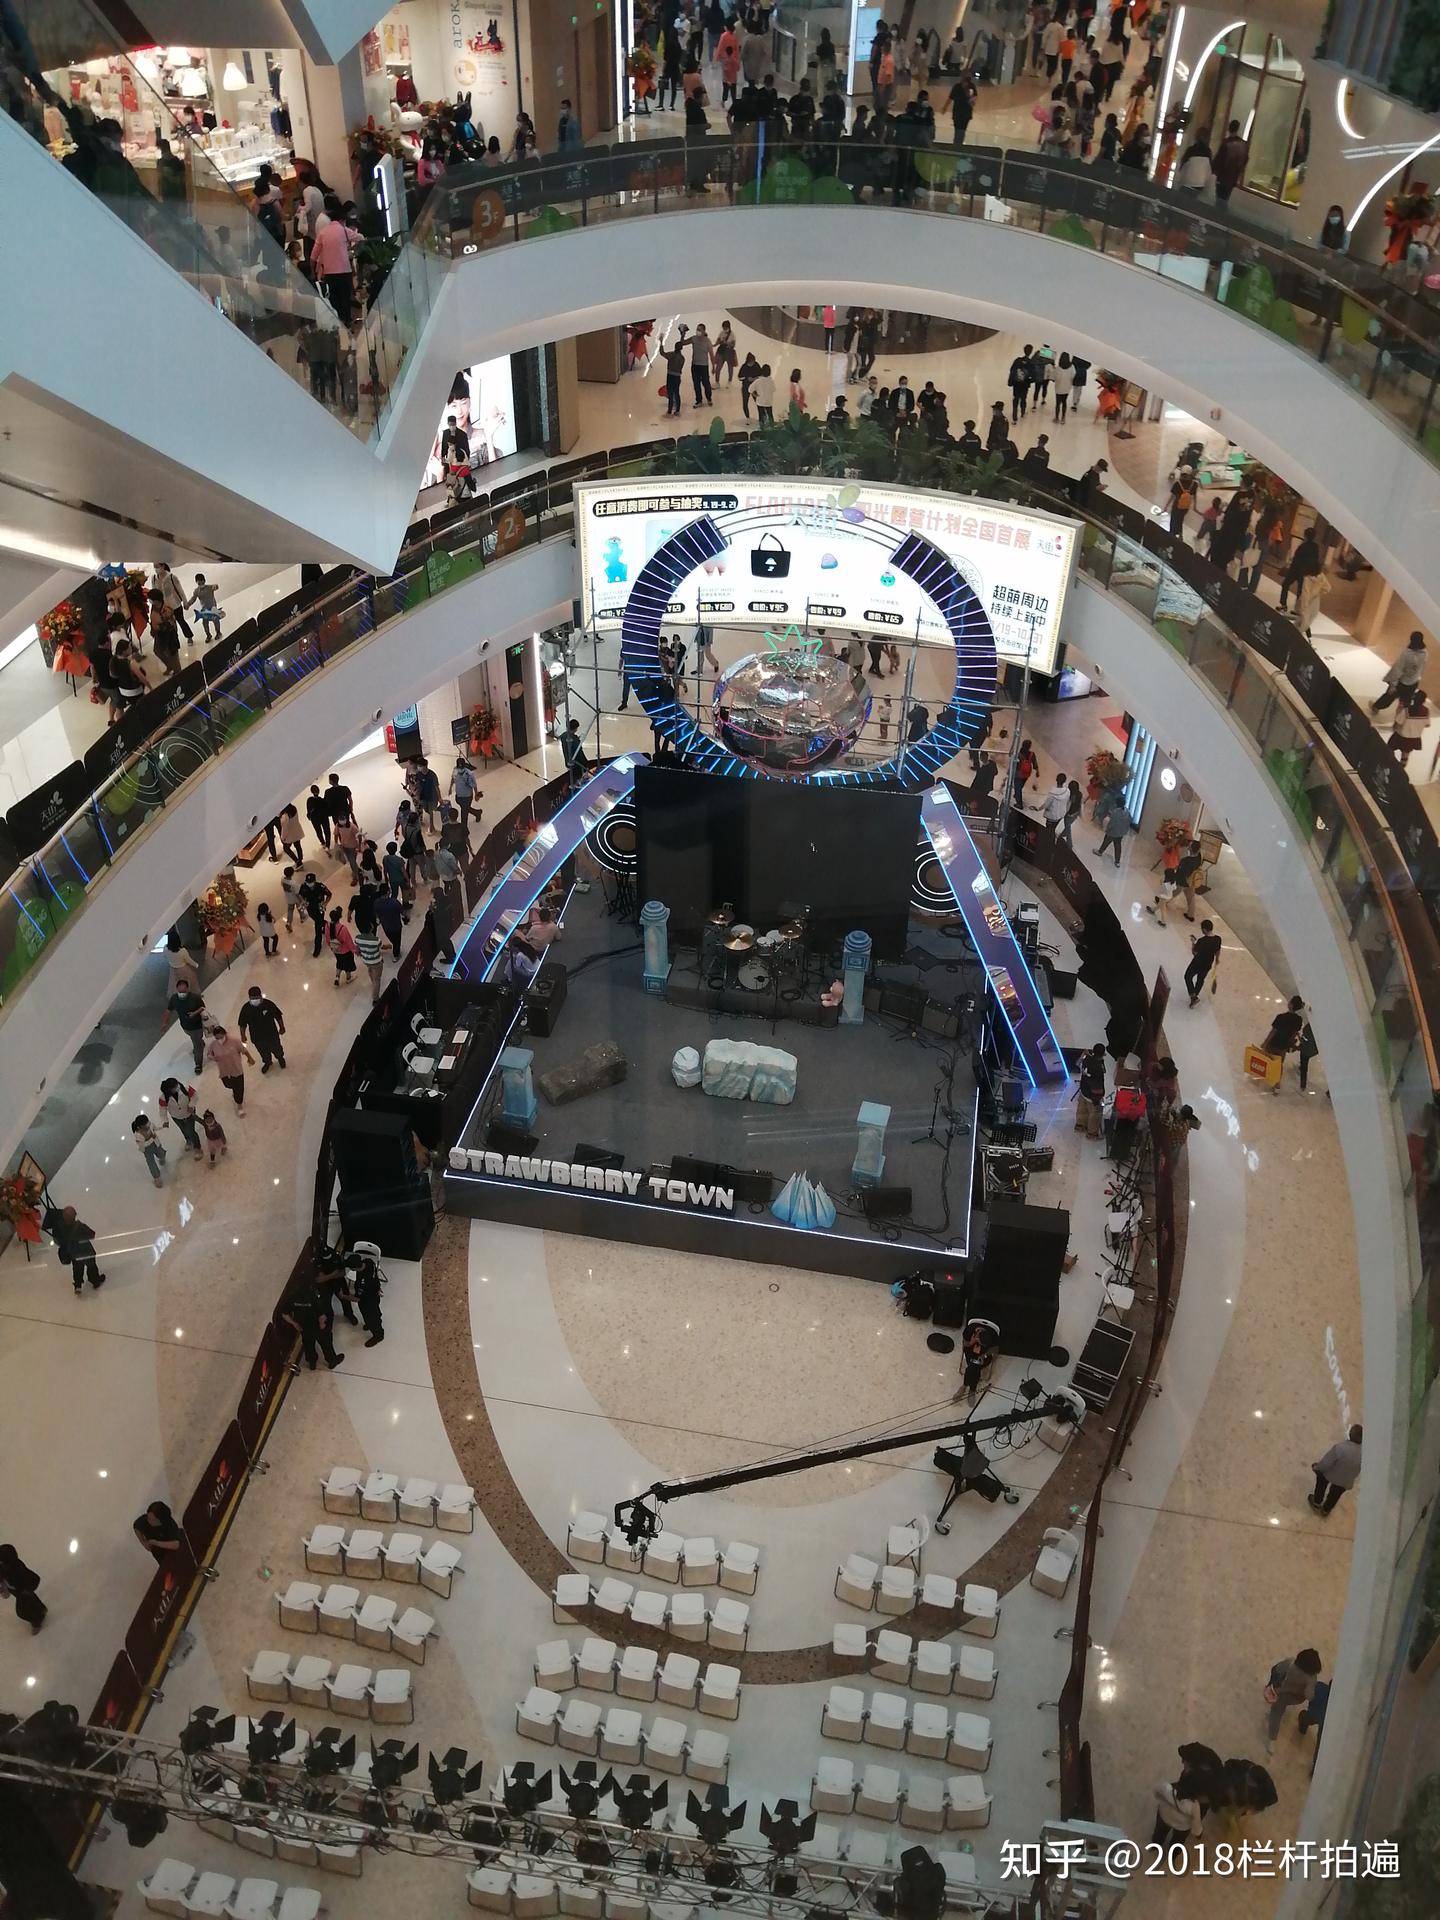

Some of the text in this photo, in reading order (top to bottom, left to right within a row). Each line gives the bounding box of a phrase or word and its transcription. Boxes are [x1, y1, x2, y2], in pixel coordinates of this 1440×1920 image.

[992, 584, 1050, 614] 超萌周边
[990, 601, 1047, 628] 持续上新中
[449, 1147, 735, 1210] STRAWBERRY TOWN
